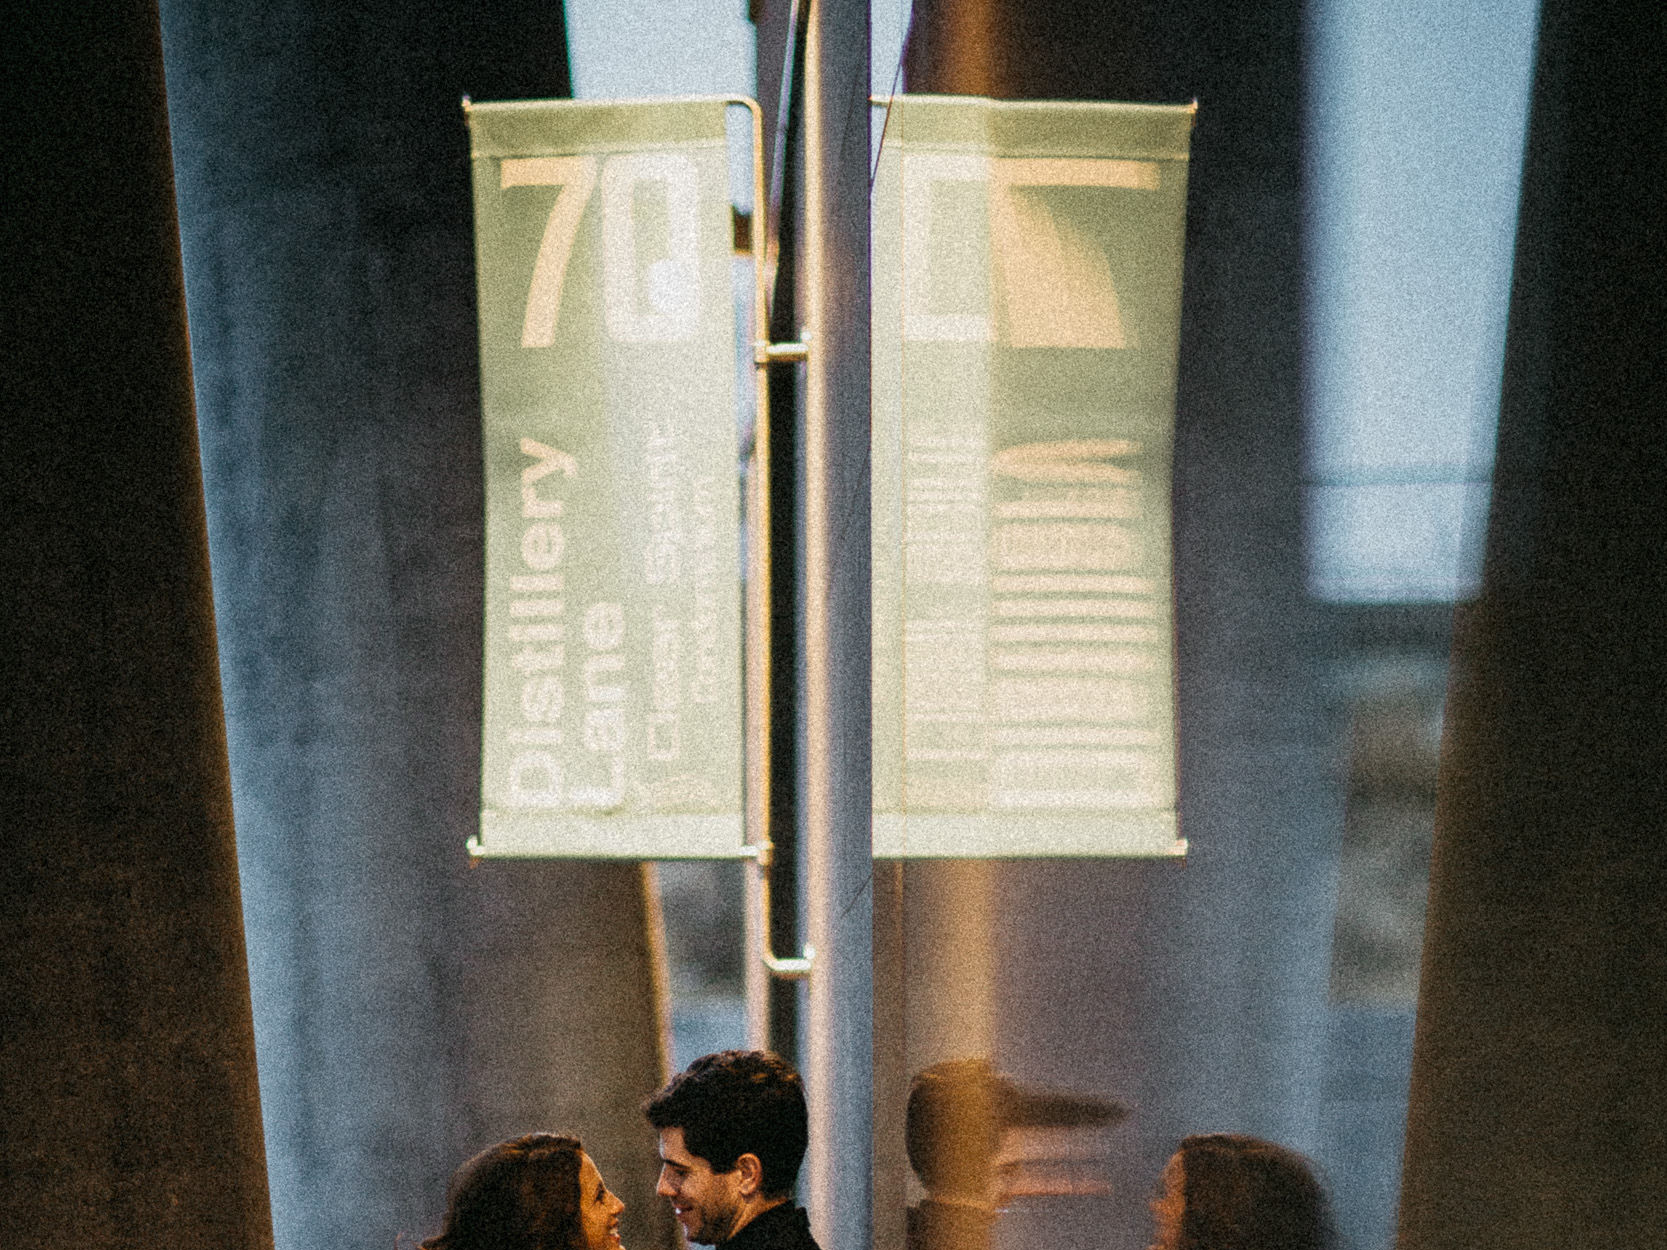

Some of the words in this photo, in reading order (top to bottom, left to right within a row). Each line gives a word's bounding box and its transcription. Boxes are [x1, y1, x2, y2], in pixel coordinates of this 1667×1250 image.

[500, 153, 699, 348] 70
[506, 437, 578, 809] Distillery
[566, 602, 627, 808] Lane
